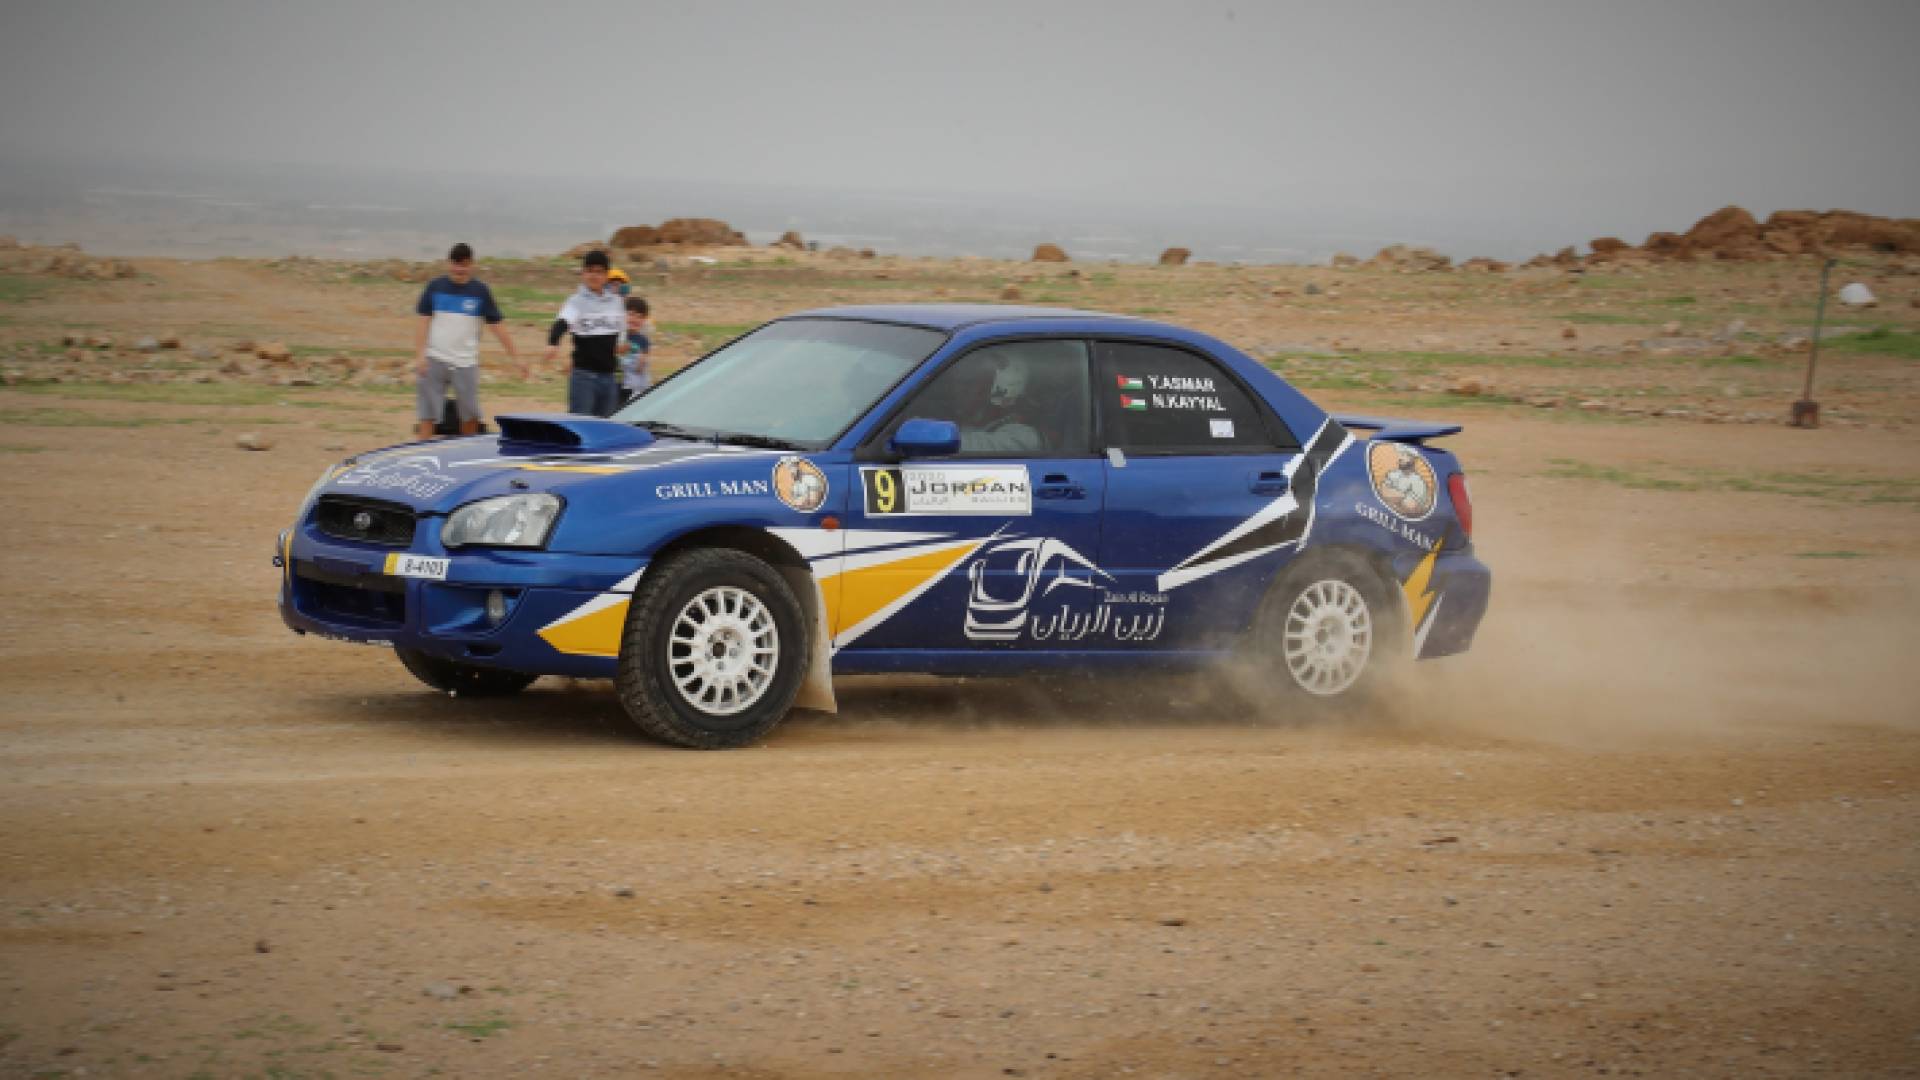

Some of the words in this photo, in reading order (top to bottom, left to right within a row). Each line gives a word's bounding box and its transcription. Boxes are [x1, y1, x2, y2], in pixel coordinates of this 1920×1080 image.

[1147, 375, 1216, 392] Y.ASMAR
[655, 482, 718, 499] GRILL
[720, 479, 769, 496] MAN
[875, 469, 897, 512] 9
[912, 480, 1025, 496] JORDAN
[1355, 502, 1399, 533] GRILL
